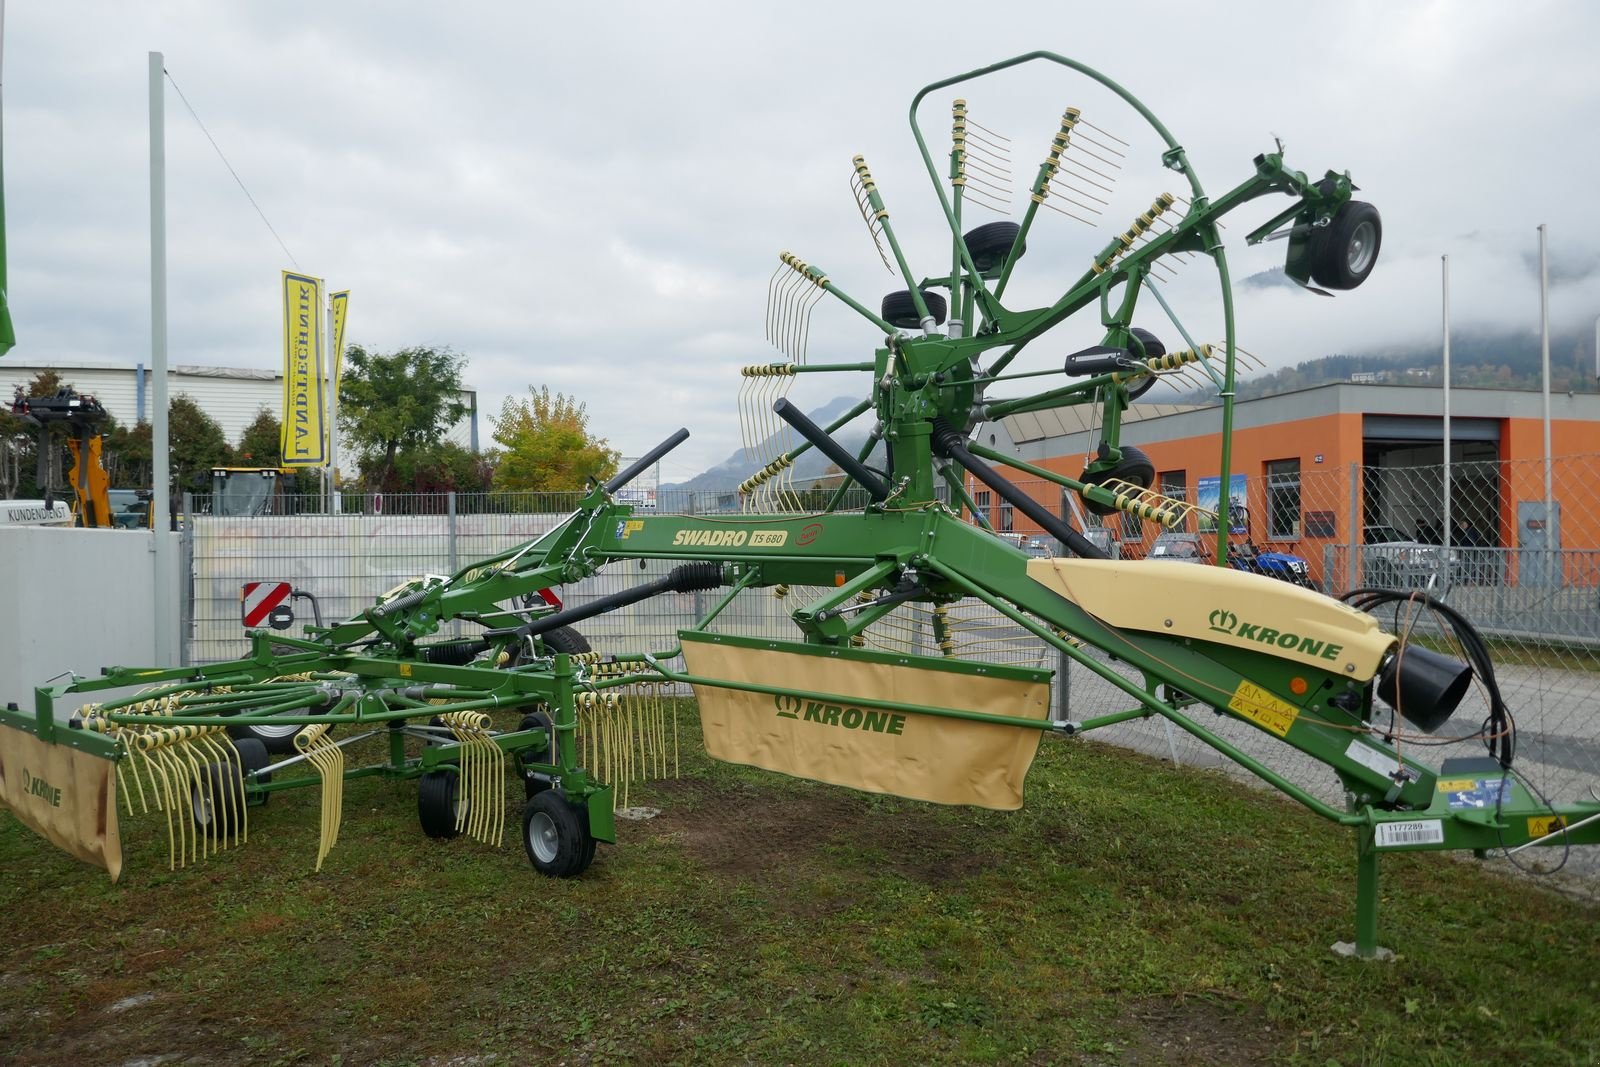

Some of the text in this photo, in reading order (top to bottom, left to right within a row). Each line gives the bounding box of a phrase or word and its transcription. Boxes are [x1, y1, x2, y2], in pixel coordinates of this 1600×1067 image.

[8, 506, 67, 521] KUNDENDIENST
[672, 530, 783, 547] SWADRO TS 680
[1236, 622, 1343, 661] KRONE
[803, 702, 906, 736] KRONE
[31, 776, 62, 808] KRNE
[1388, 822, 1423, 832] 1177289
